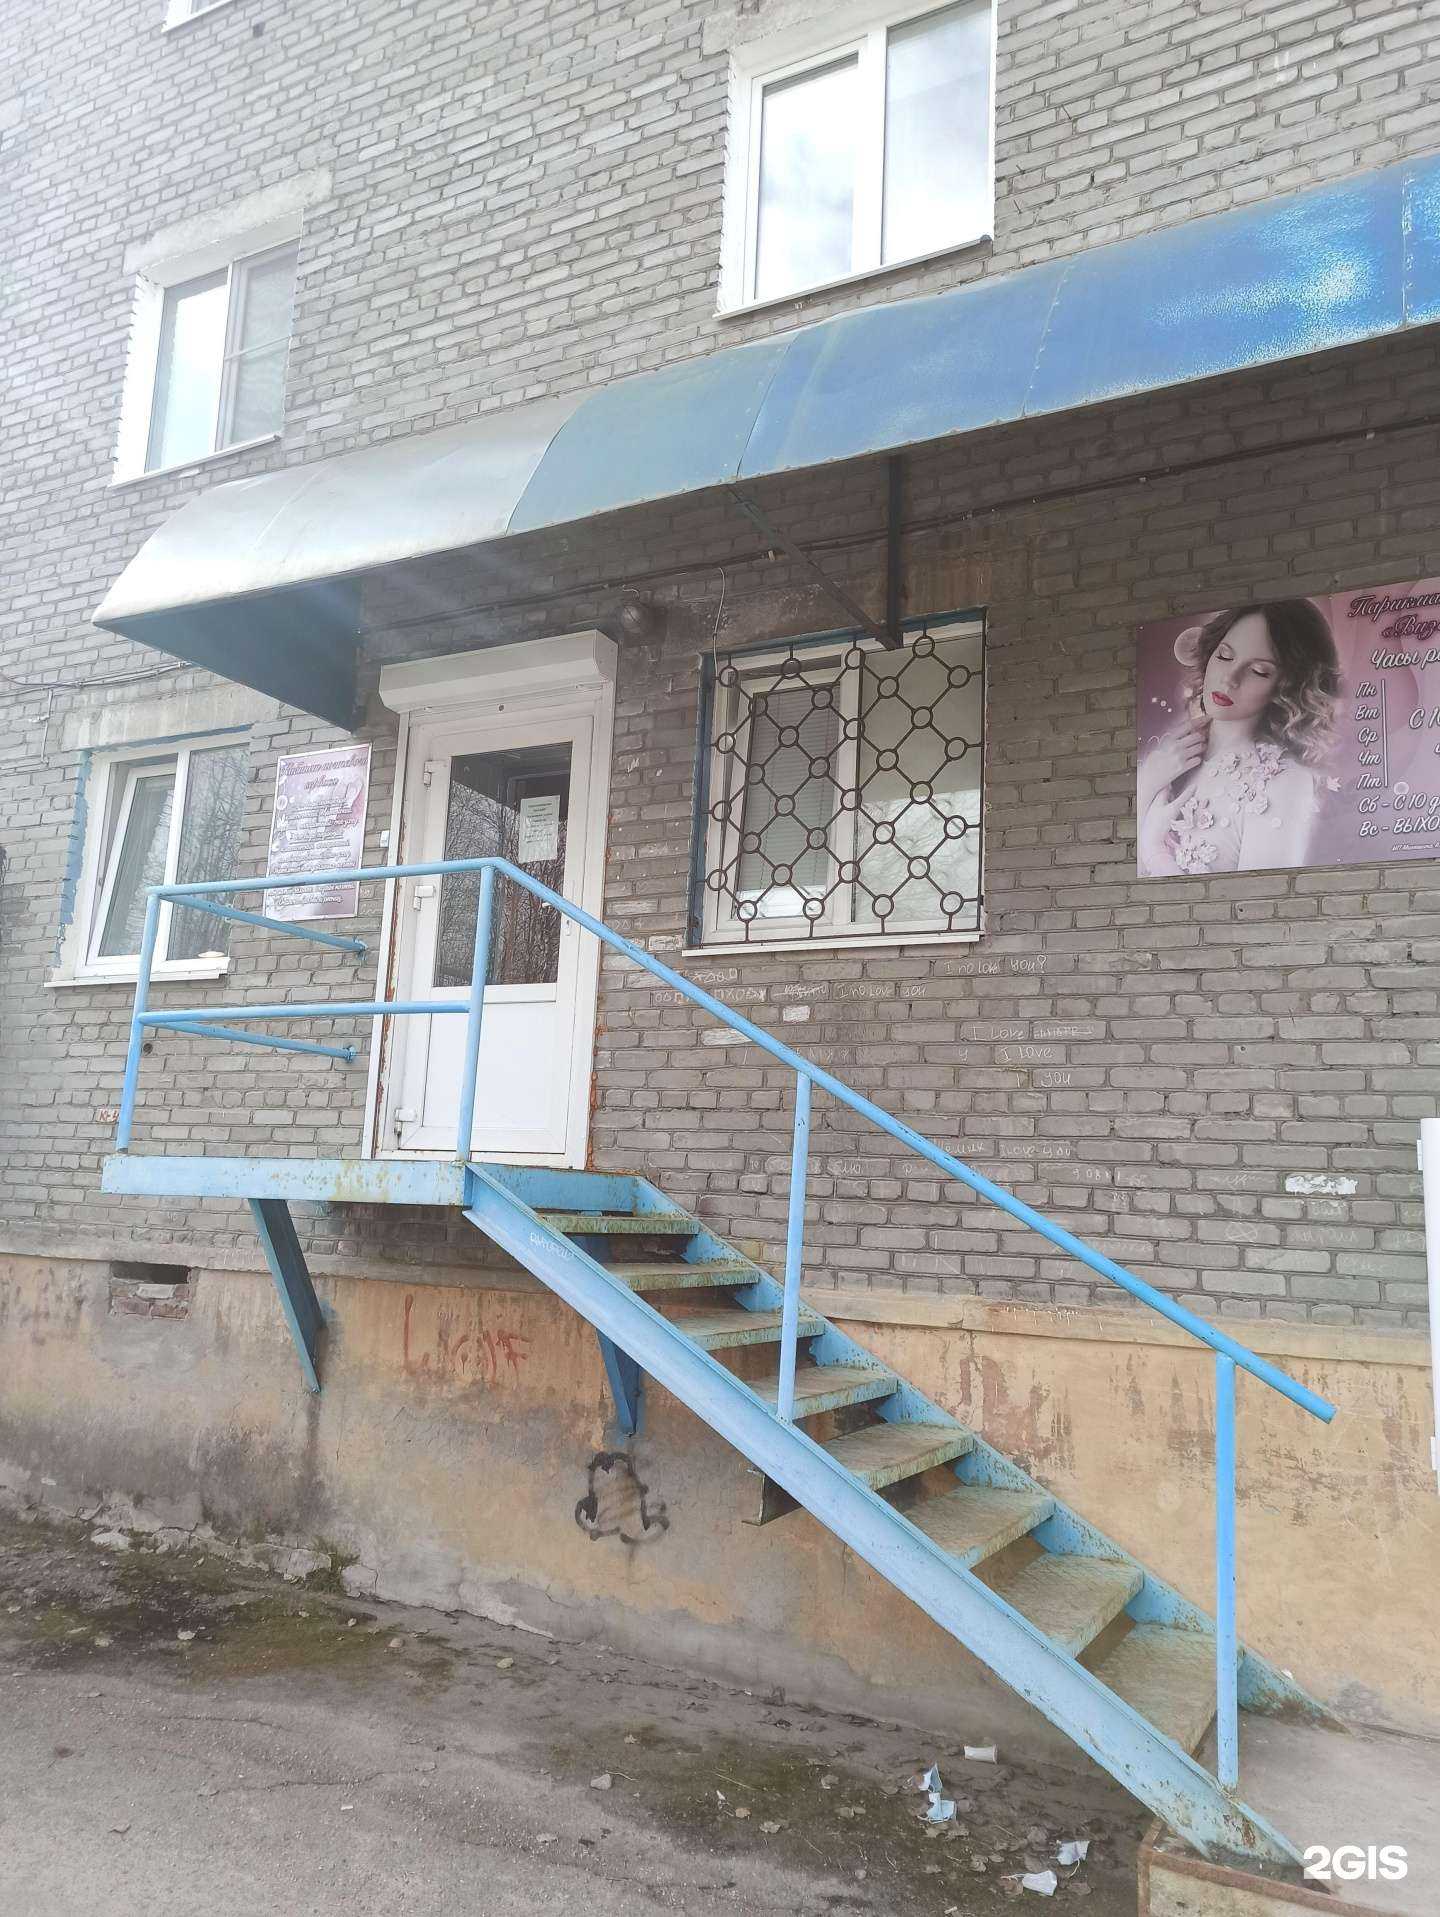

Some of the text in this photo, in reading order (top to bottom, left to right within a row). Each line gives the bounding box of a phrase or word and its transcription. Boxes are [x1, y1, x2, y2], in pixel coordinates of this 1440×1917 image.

[1381, 613, 1440, 641] «Виз
[1371, 648, 1420, 669] Часы
[1355, 681, 1377, 698] Пн
[1355, 704, 1379, 720] Вт
[1409, 707, 1425, 729] С
[1358, 727, 1379, 747] Ср
[1358, 750, 1382, 765] Чт
[1356, 773, 1382, 790] Пт
[1359, 795, 1380, 813] Сб
[1394, 794, 1406, 810] С
[1408, 792, 1427, 808] 10
[1429, 796, 1440, 815] д
[1359, 820, 1379, 837] Вс
[1393, 814, 1440, 835] ВЫХО
